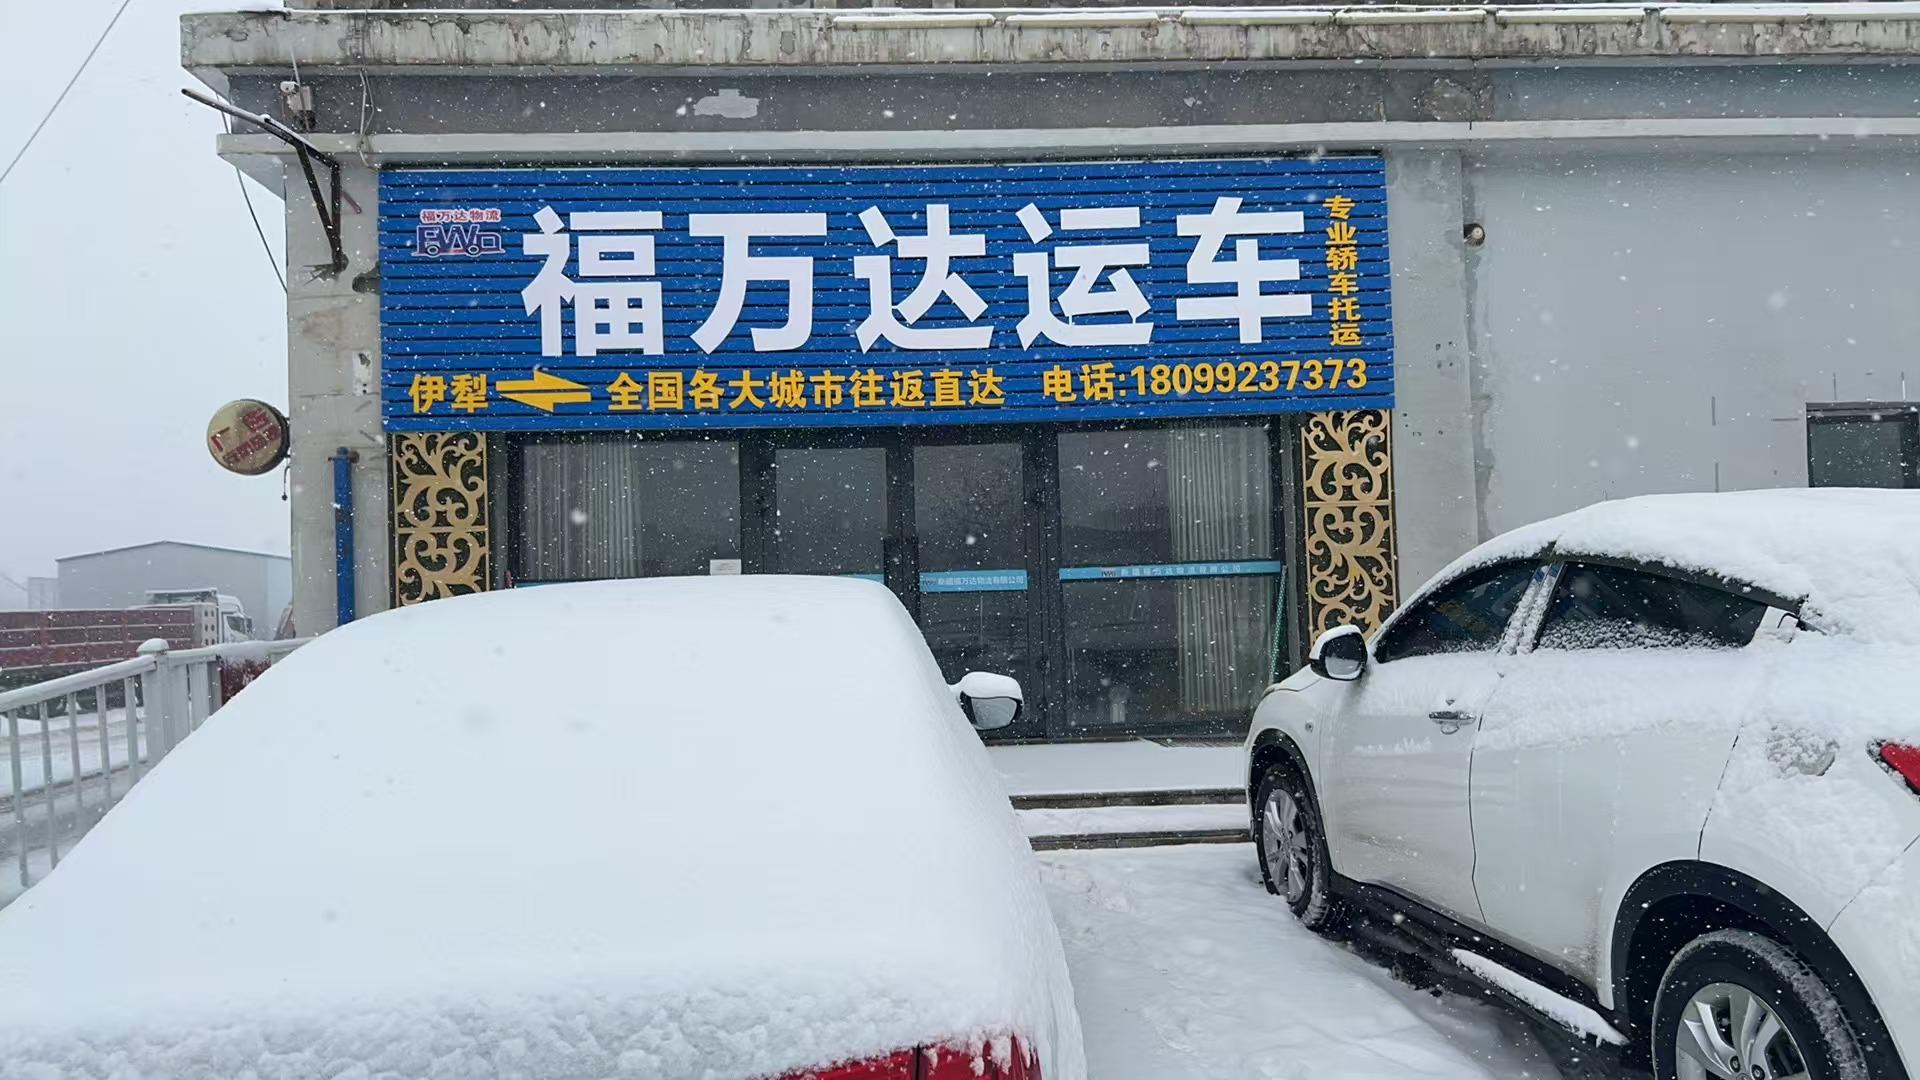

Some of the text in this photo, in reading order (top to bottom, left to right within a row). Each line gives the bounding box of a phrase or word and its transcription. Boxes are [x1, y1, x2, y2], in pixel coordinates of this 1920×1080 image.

[421, 208, 501, 223] 福万达物流
[521, 196, 1312, 357] 福万达运车
[1323, 195, 1362, 346] 专业轿车托运
[408, 368, 1005, 413] 伊犁 全国各大城市往返直达
[1043, 359, 1367, 402] 电话:18099237373
